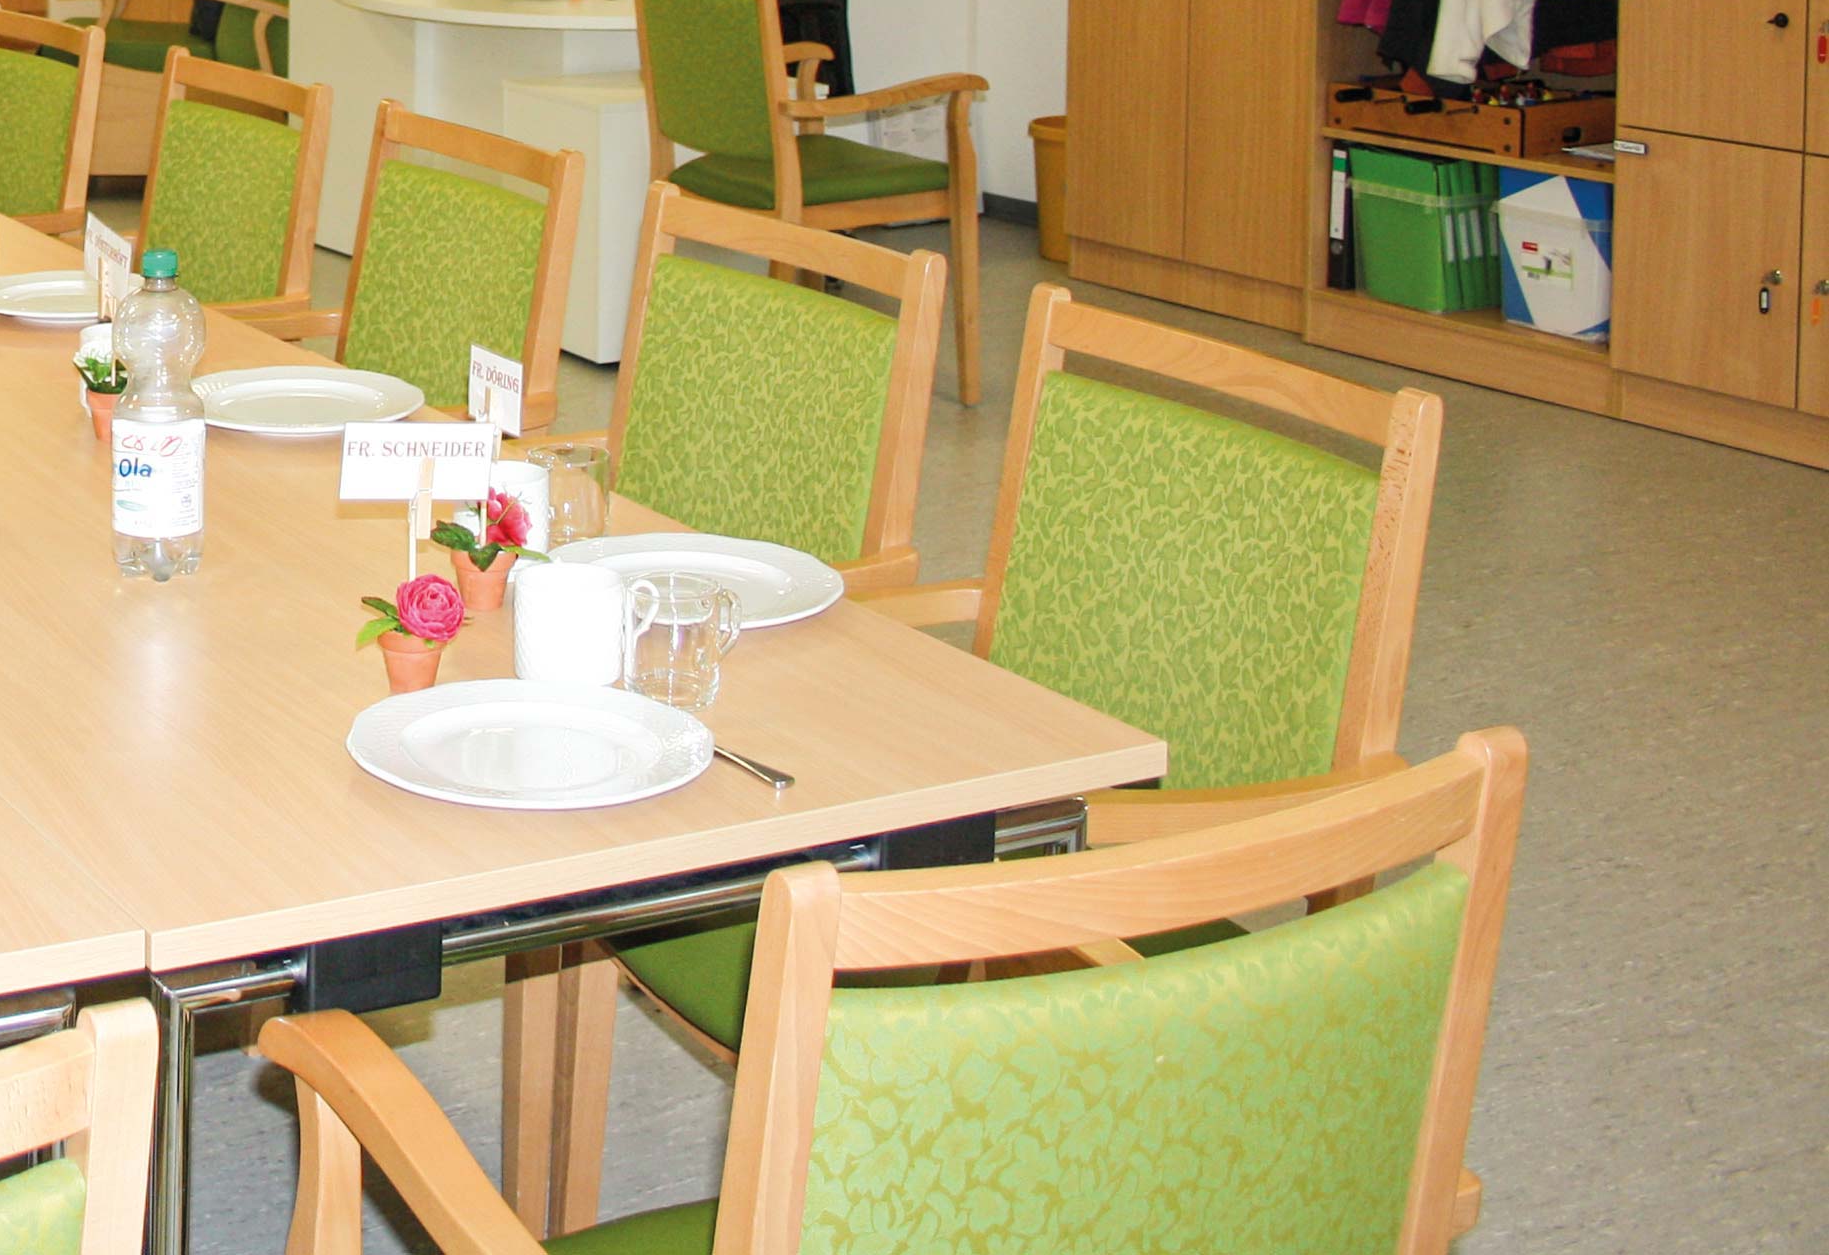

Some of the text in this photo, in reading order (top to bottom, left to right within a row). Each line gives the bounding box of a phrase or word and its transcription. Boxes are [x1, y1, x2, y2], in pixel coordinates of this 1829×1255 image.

[485, 365, 520, 394] DÖRING
[347, 440, 486, 458] FR. SCHNEIDER
[116, 456, 154, 478] Ola
